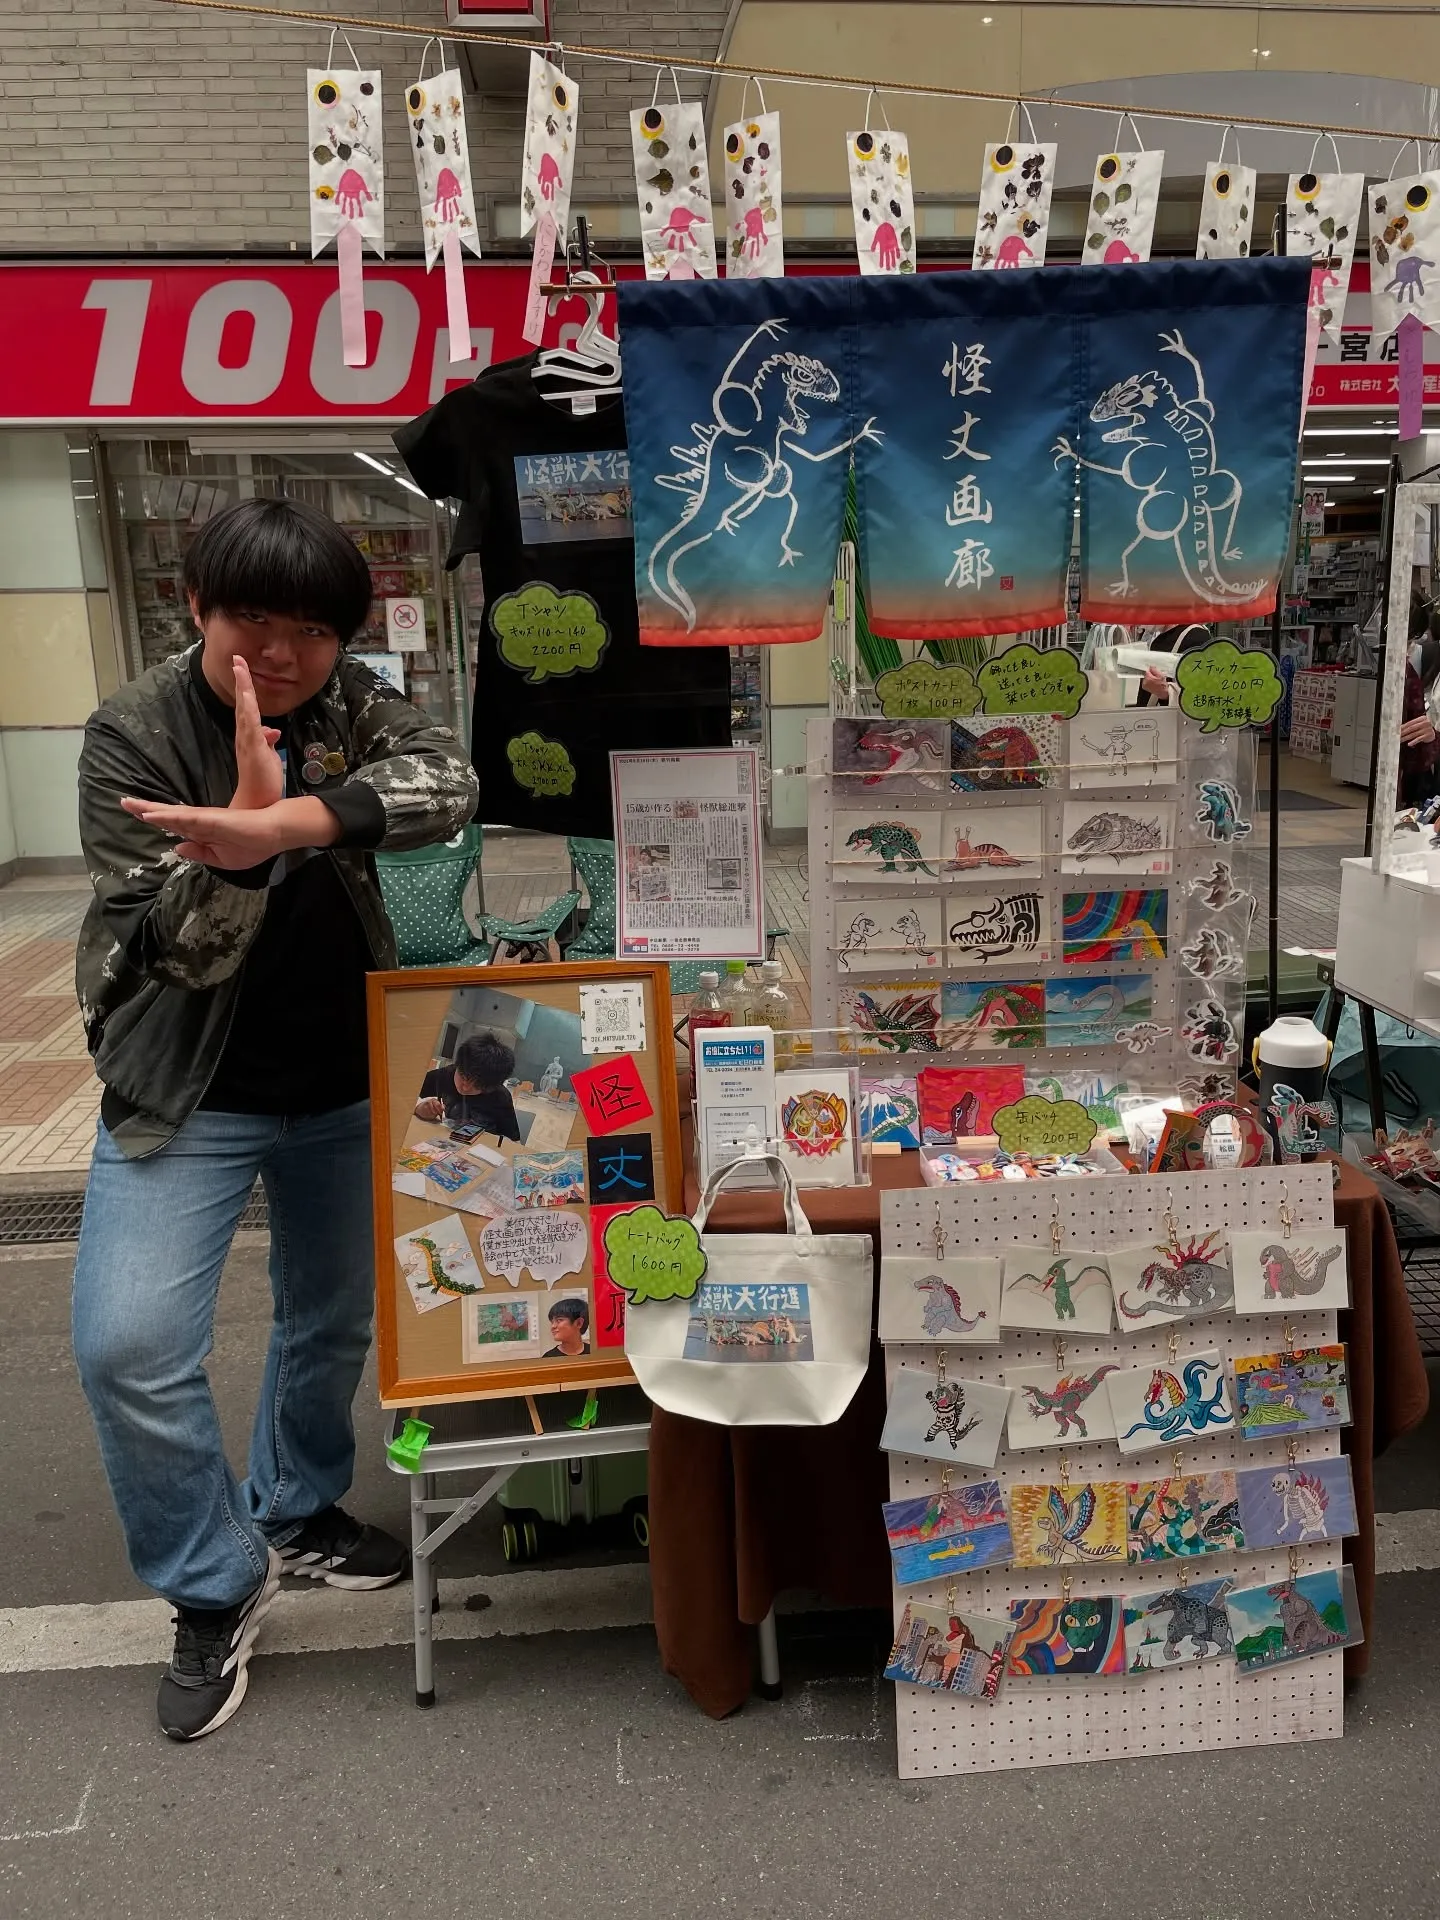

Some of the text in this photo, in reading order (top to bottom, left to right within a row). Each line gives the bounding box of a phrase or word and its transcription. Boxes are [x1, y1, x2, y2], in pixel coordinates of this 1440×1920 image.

[1340, 379, 1381, 392] 株式会社
[516, 604, 567, 619] Tシャツ
[532, 643, 581, 655] 2200円
[1192, 660, 1258, 675] ステッカー
[895, 679, 960, 692] ポストカード
[1221, 679, 1264, 689] 200円
[929, 698, 962, 710] 100円
[1193, 694, 1243, 707] 超耐水!
[590, 1073, 641, 1121] 怪
[1042, 1132, 1079, 1145] 200円
[598, 1148, 648, 1190] 丈
[628, 1228, 685, 1250] トートバッグ
[632, 1255, 682, 1276] 1600円
